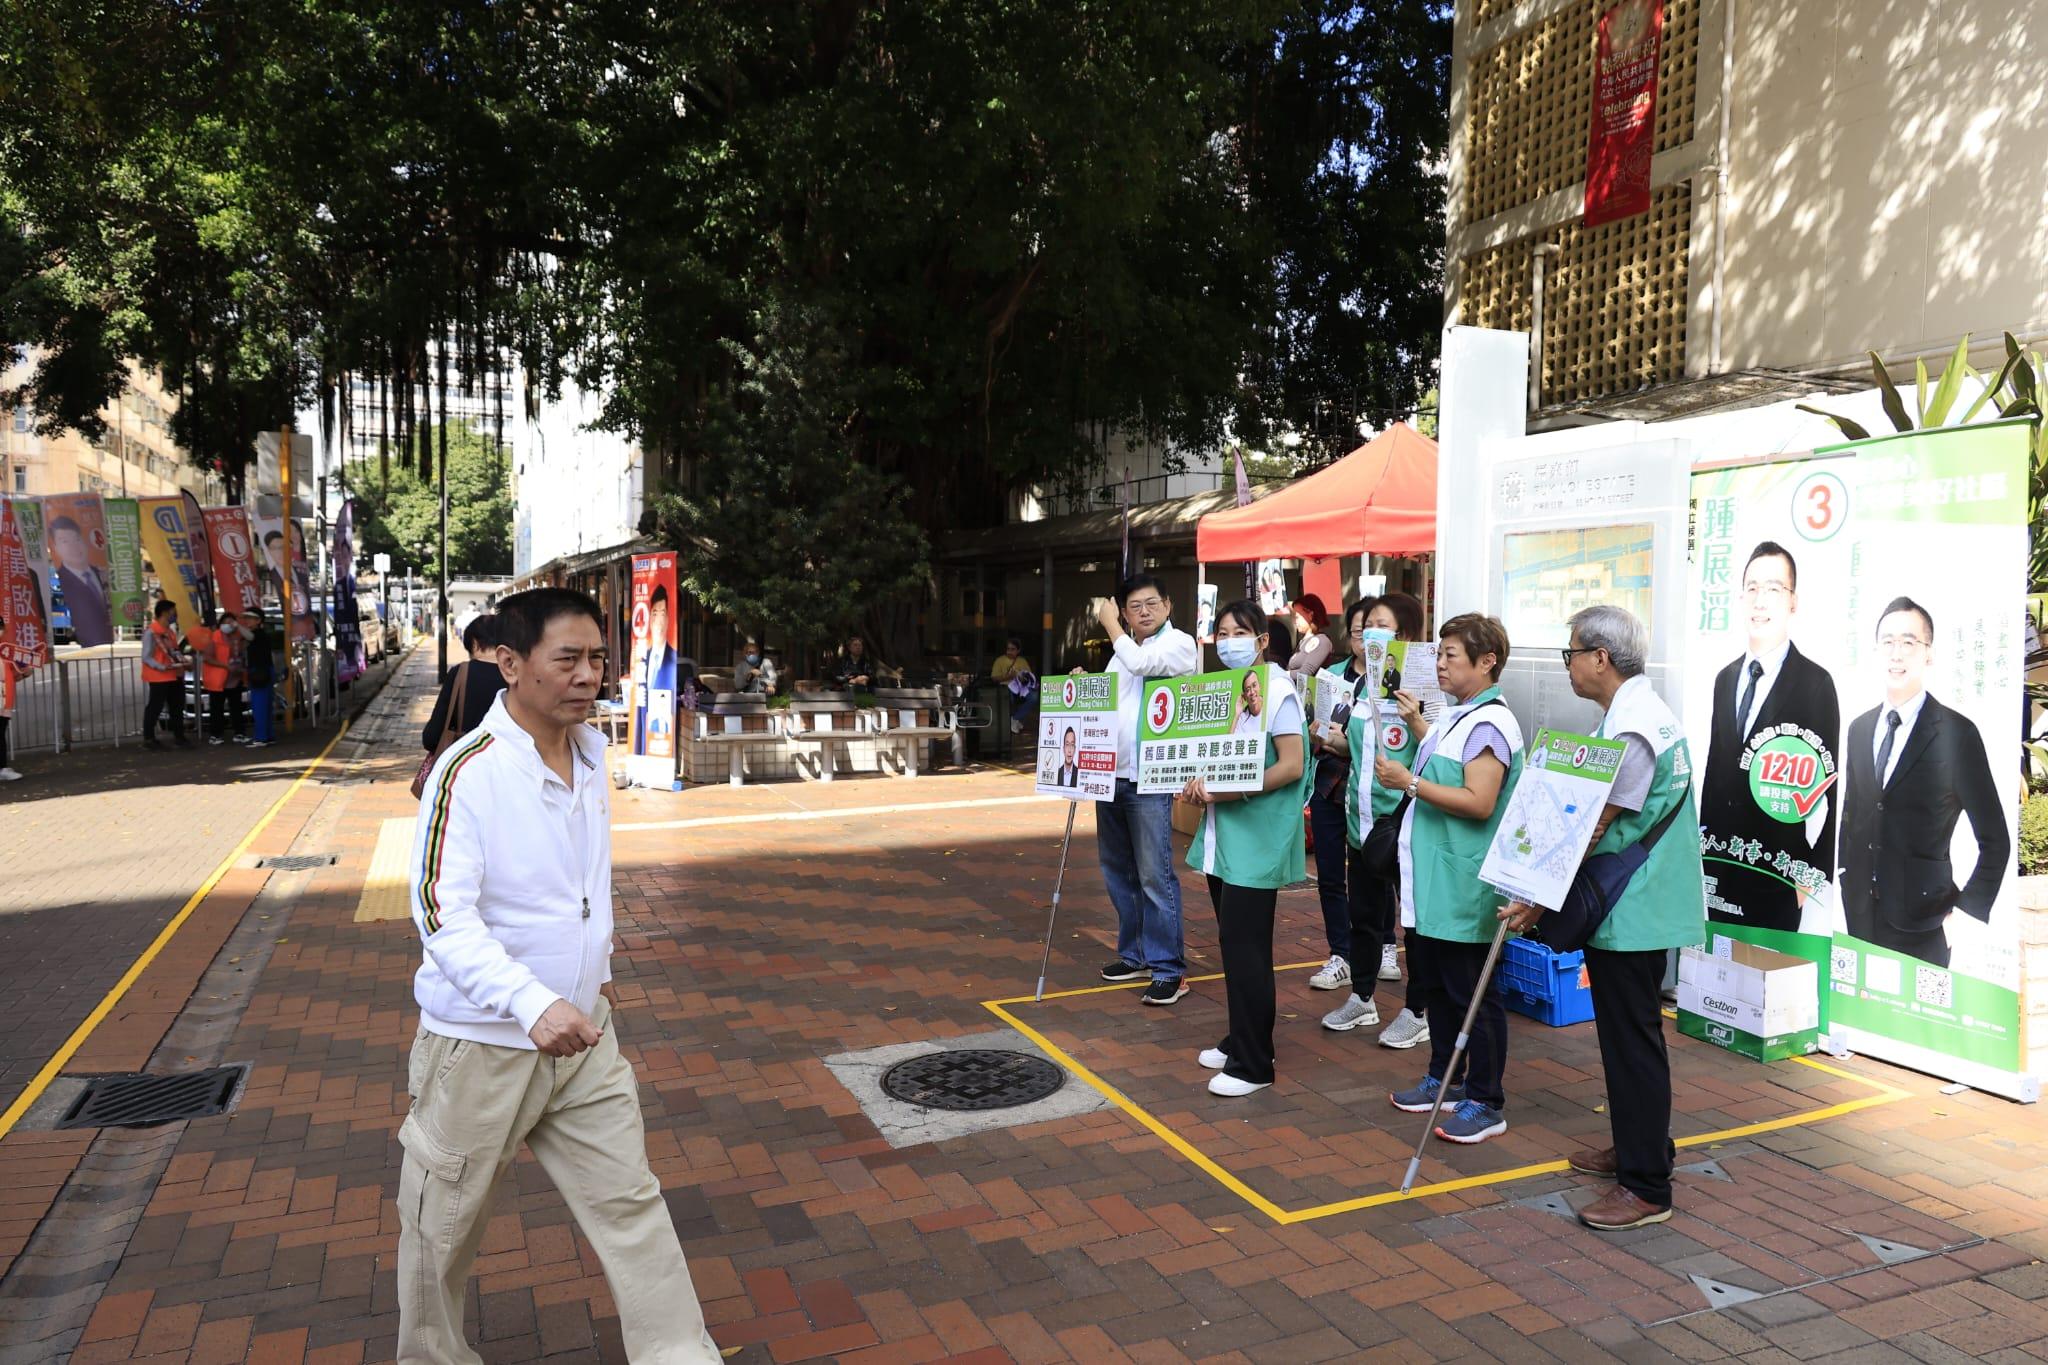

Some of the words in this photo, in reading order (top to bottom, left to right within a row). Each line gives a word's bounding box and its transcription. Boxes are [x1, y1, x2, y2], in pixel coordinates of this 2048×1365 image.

[1807, 484, 1832, 530] 3
[635, 607, 645, 632] 4
[1430, 646, 1436, 656] 3
[1065, 682, 1073, 704] 3
[1153, 692, 1168, 727] 3
[1048, 722, 1054, 736] 3
[1387, 727, 1402, 746] 3
[1575, 747, 1586, 764] 3
[1760, 751, 1816, 788] 1210
[1760, 786, 1791, 800] 請投票
[1771, 801, 1790, 814] 支持
